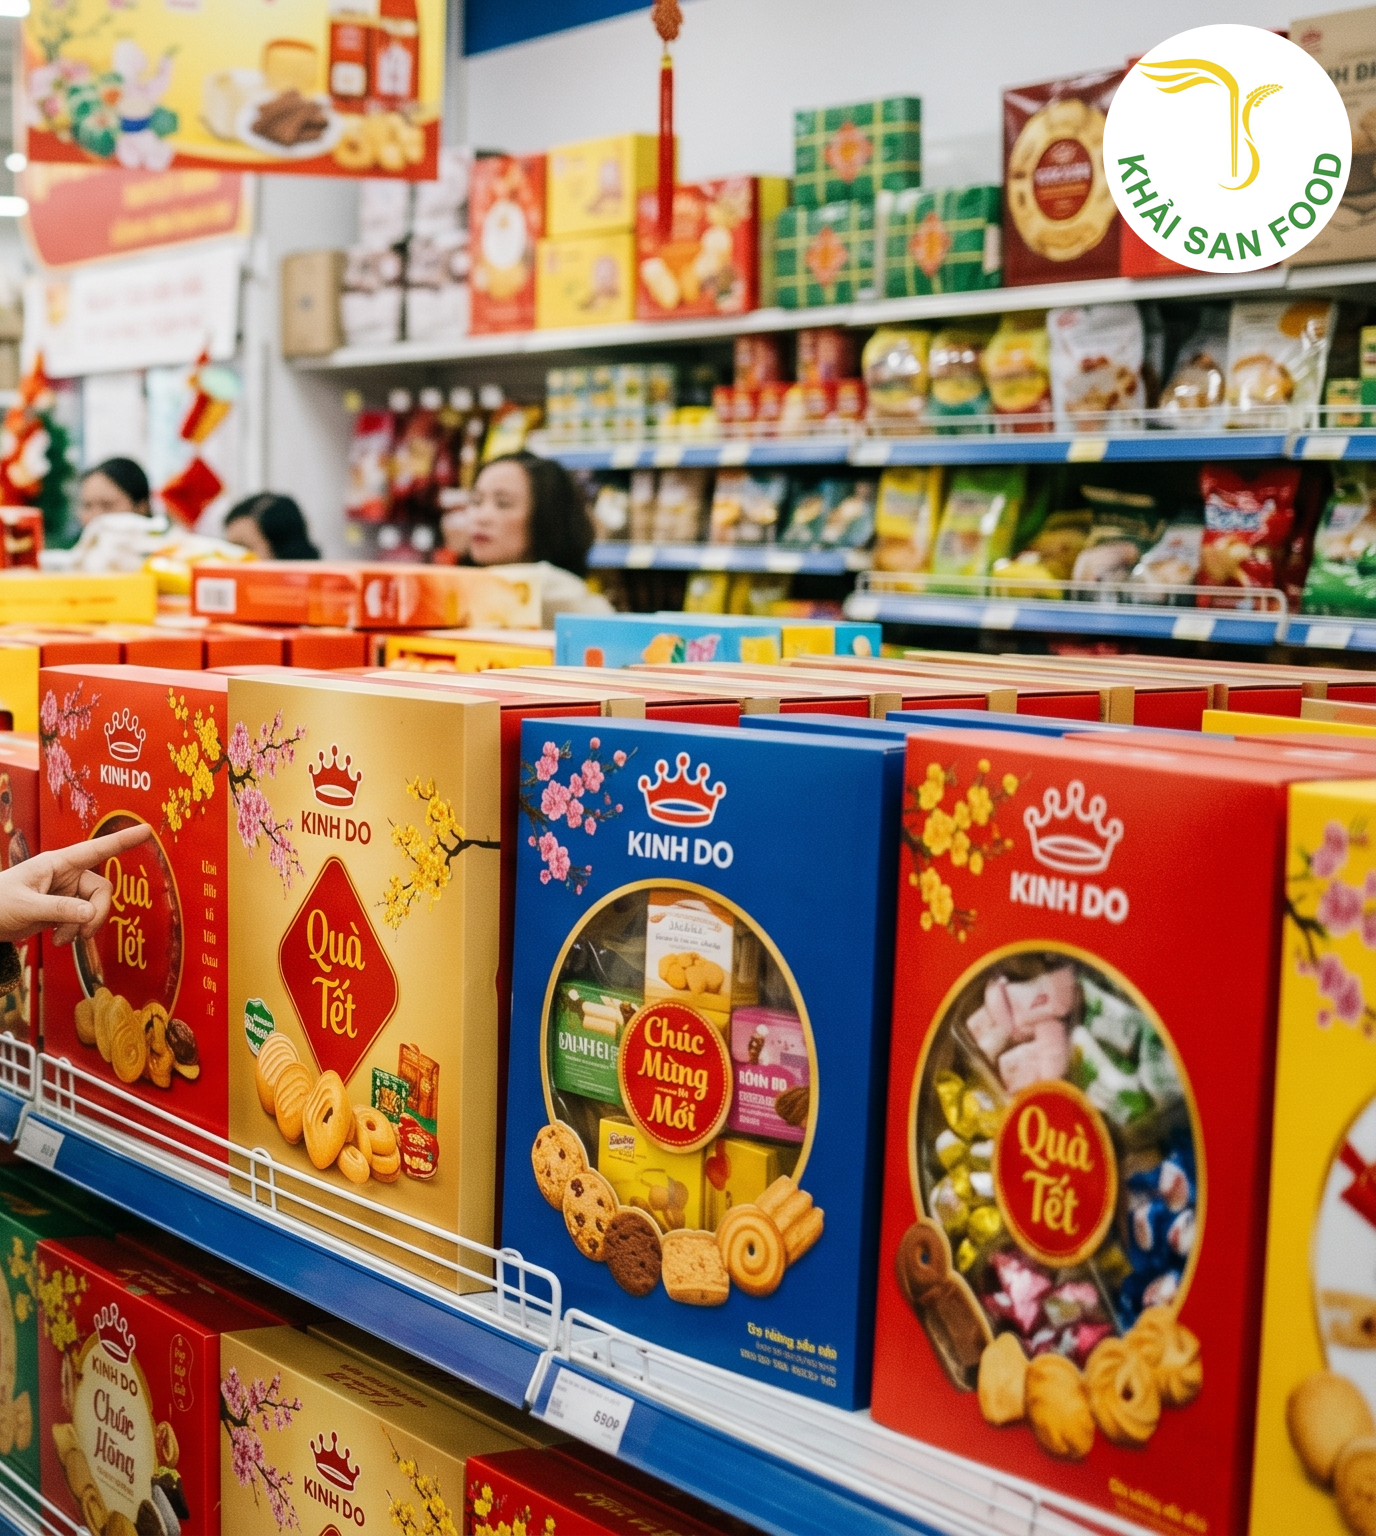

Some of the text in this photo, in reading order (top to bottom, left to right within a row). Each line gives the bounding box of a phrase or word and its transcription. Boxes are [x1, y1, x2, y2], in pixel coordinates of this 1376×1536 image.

[100, 764, 151, 791] KINH DO
[301, 810, 372, 845] KINH DO
[628, 830, 734, 869] KINH DO
[105, 856, 153, 912] Quà
[1010, 871, 1129, 924] KINH DO
[109, 916, 147, 970] Tết
[307, 908, 366, 973] Quà
[312, 976, 358, 1039] Tết
[644, 1016, 705, 1055] Chúc
[637, 1049, 708, 1101] Mừng
[647, 1094, 696, 1132] Mới
[1018, 1105, 1094, 1173] Quà
[1024, 1172, 1080, 1236] Tết
[92, 1355, 138, 1397] KINH DO
[304, 1476, 365, 1527] KINH DO
